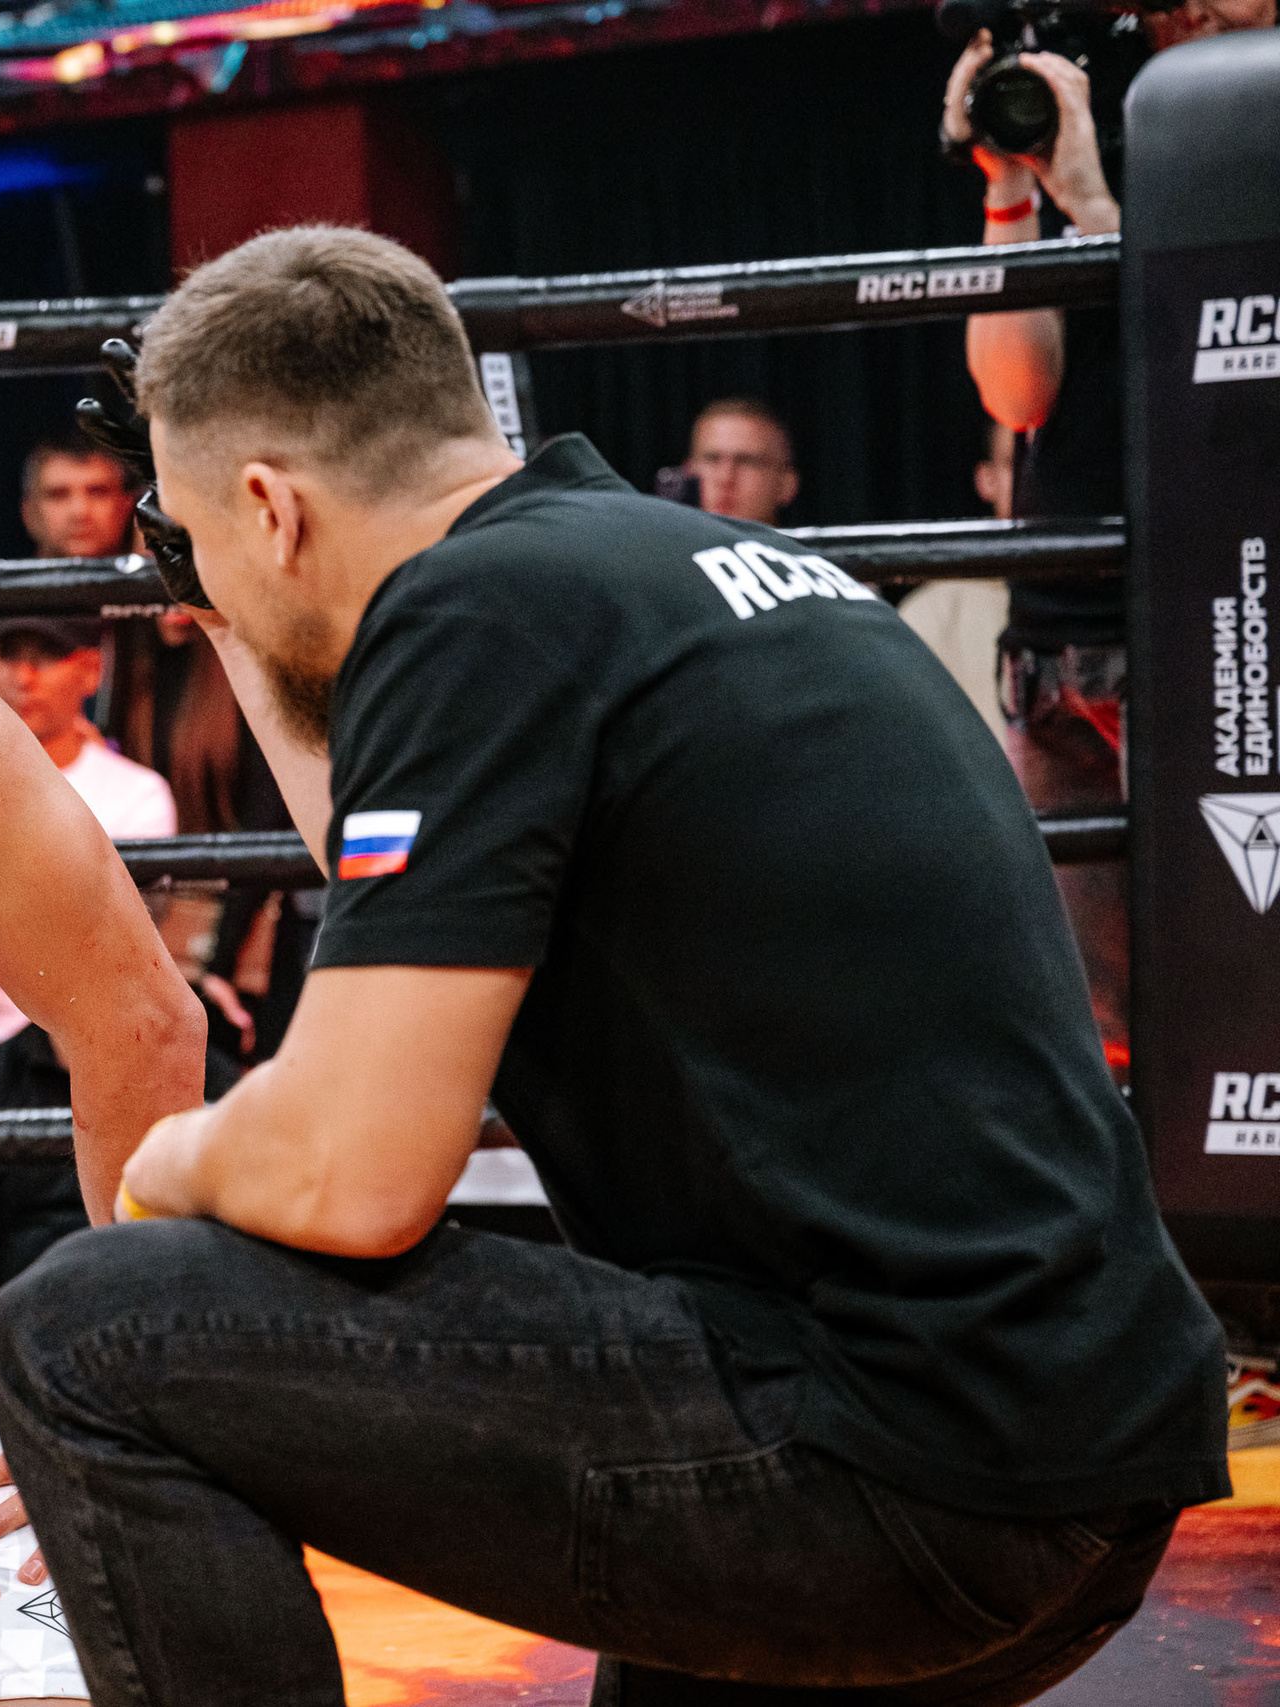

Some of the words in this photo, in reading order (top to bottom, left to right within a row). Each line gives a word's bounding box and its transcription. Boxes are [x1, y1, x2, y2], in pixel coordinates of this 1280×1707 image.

[856, 271, 926, 304] RCC
[1198, 294, 1280, 348] RC
[1214, 597, 1241, 777] АКАДЕМИЯ
[1241, 537, 1273, 776] ЕДИНОБОРСТВ
